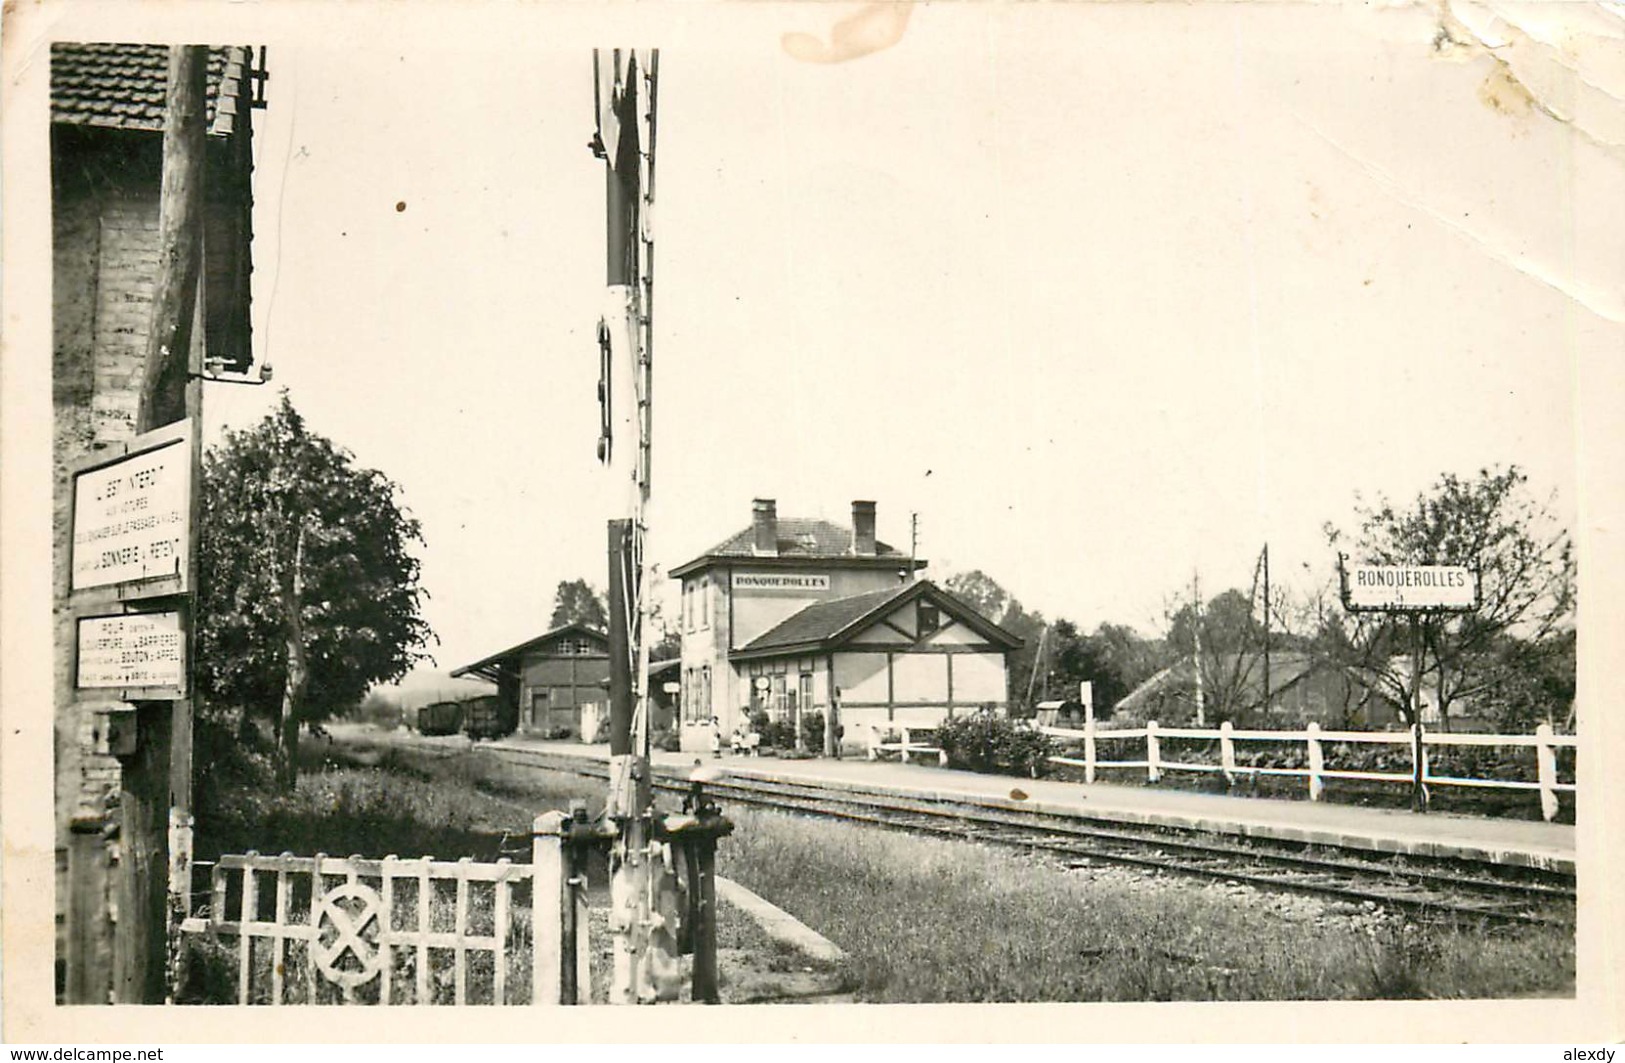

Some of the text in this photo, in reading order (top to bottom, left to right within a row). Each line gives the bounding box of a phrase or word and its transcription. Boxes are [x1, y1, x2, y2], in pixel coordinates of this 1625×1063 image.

[102, 545, 139, 570] SONNERIE
[736, 576, 826, 588] RONQUEROLLES
[1357, 570, 1465, 587] RONQUEROLLES
[102, 622, 124, 635] POUR
[121, 650, 149, 663] BOUTON
